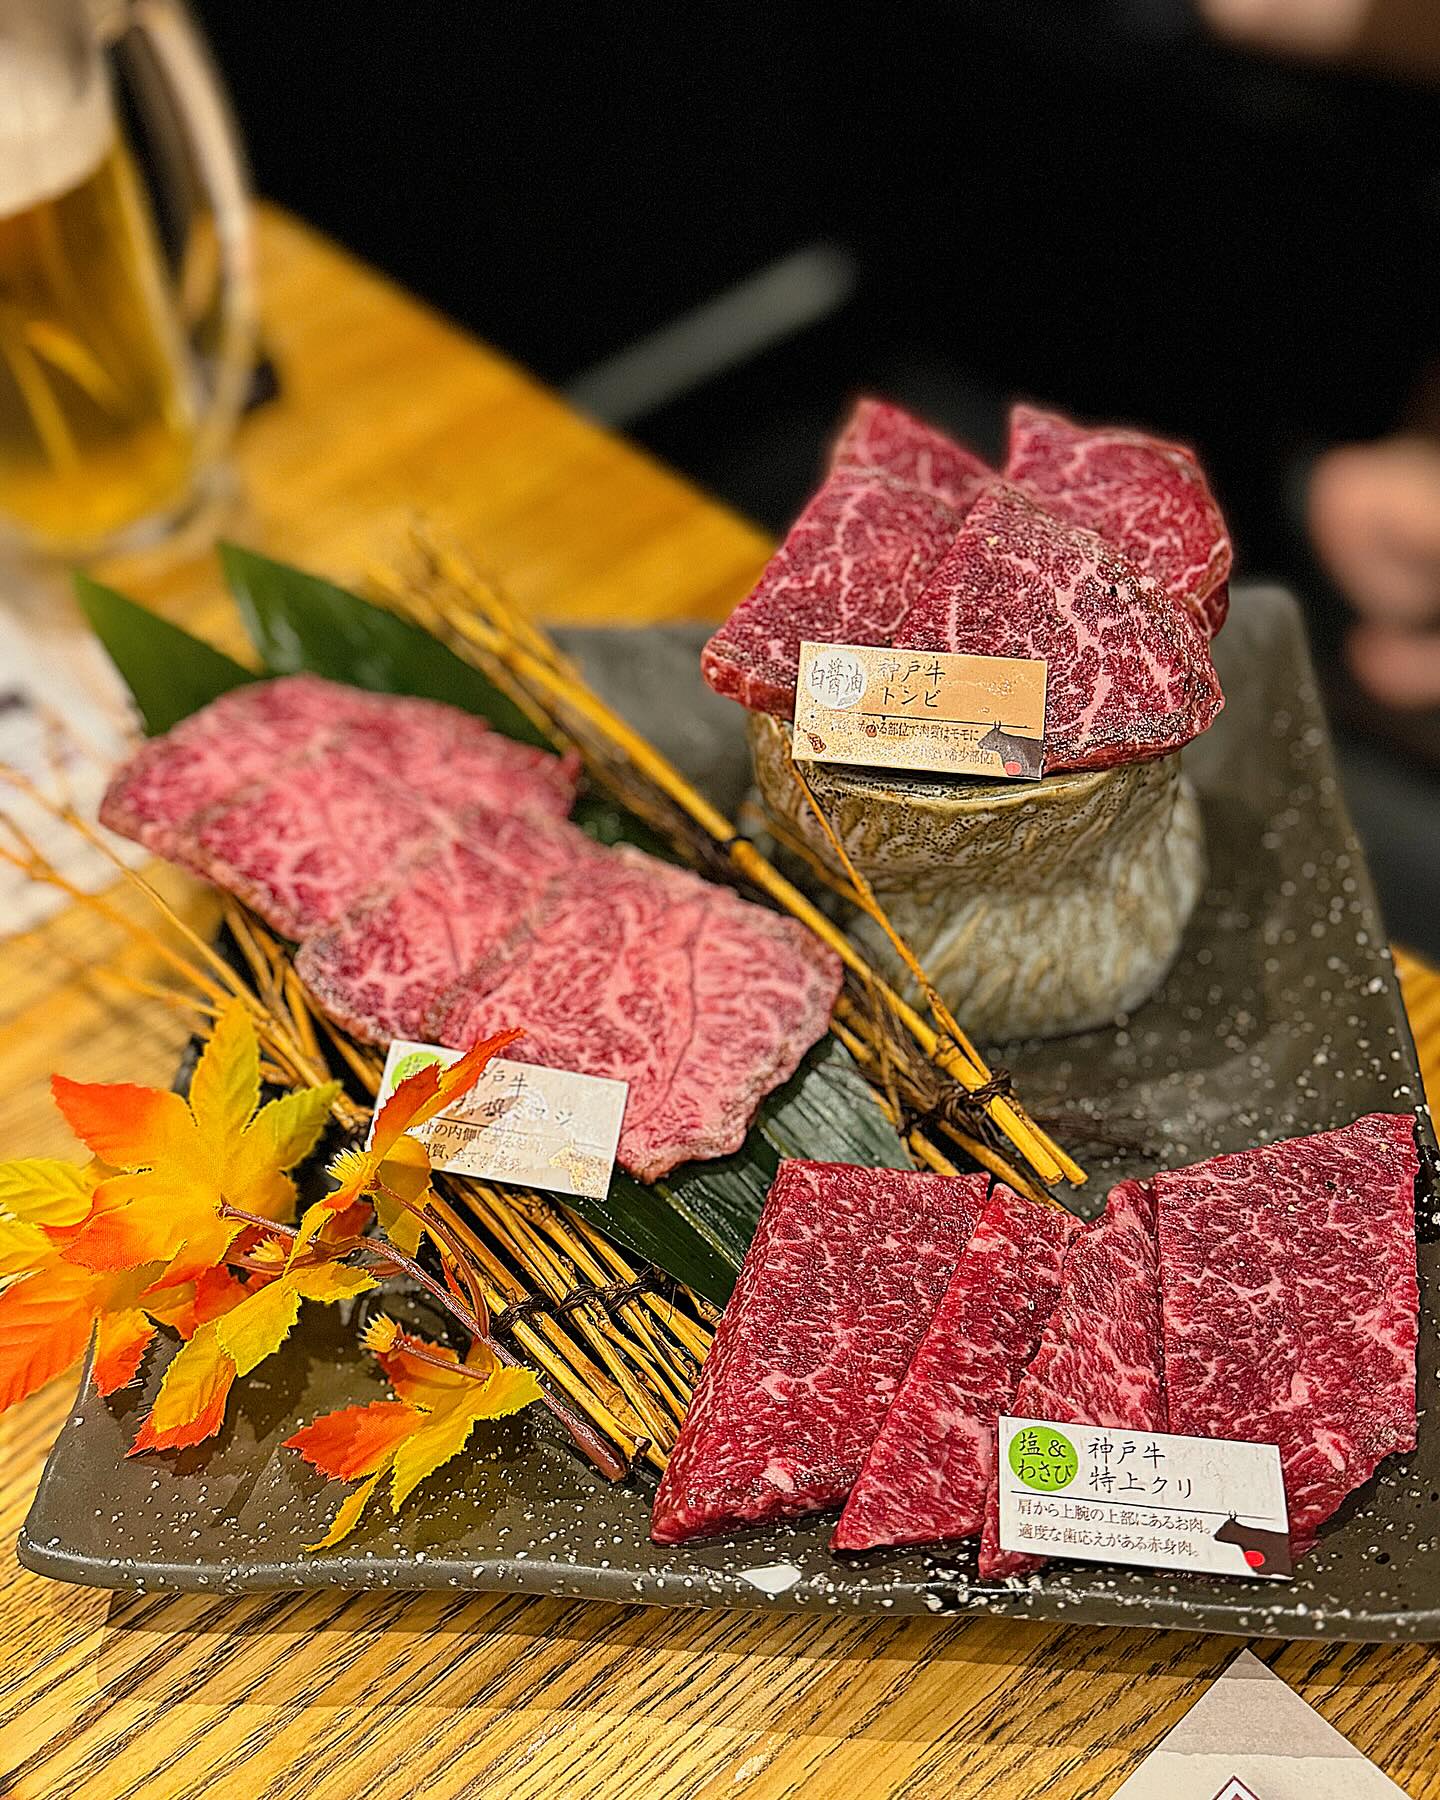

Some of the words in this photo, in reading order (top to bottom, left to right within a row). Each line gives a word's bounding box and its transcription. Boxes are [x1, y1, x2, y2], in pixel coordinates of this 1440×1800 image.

[878, 657, 946, 686] 神戸牛
[884, 687, 941, 708] トンビ
[1088, 1436, 1166, 1469] 神戸牛
[1018, 1460, 1073, 1484] わさび
[1089, 1466, 1193, 1499] 特上クリ
[1018, 1499, 1212, 1536] 肩から上腕の上部にあるお肉。
[1018, 1522, 1200, 1558] 適度な歯応えがある赤身肉。
